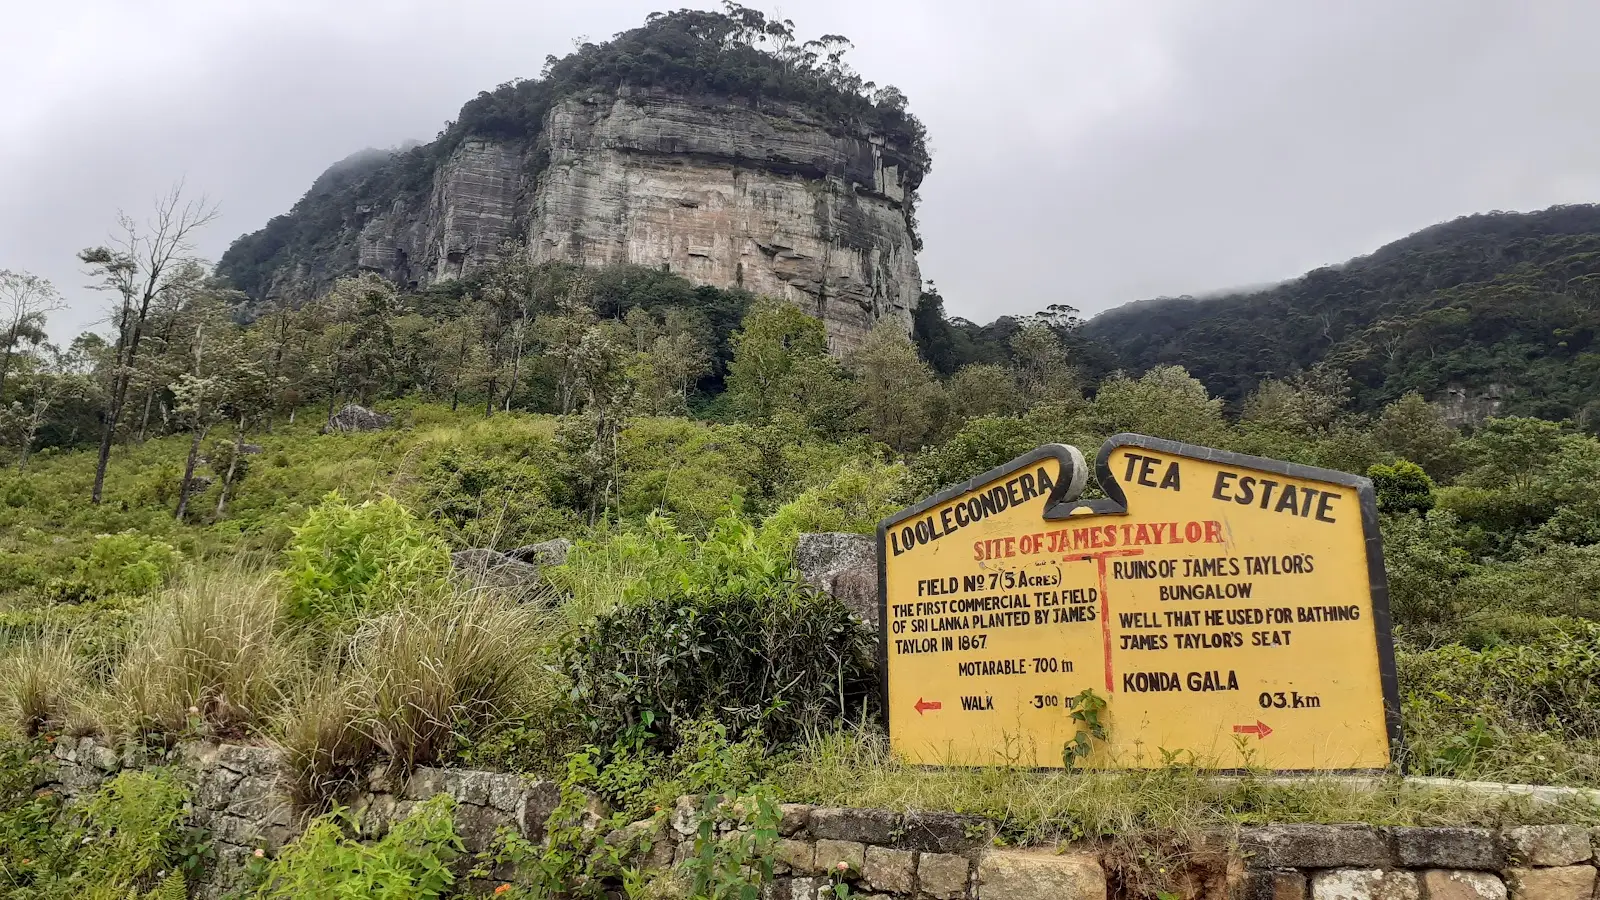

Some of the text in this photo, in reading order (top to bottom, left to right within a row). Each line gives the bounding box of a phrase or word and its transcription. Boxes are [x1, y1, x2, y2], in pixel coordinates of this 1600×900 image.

[890, 453, 1342, 557] LOOLECONDERA TEA ESTATE
[973, 520, 1225, 561] SITE OF JAMES TAYLOR
[1113, 553, 1314, 580] RUINS OF JAMES TAYLOR'S
[918, 577, 959, 597] FIELD
[1159, 583, 1252, 601] BUNGALOW
[892, 587, 1098, 618] THE FIRST COMMERCIAL TEA FIELD
[892, 620, 906, 634] OF
[911, 618, 928, 633] SRI
[931, 615, 969, 631] LANKA
[972, 610, 1030, 629] PLANTED
[1034, 608, 1050, 625] BY
[1119, 605, 1360, 629] WELL THAT HE USED FOR BATHING
[895, 637, 938, 654] TAYLOR
[941, 636, 953, 651] IN
[1120, 630, 1292, 651] JAMES TAYLOR'S SEAT
[958, 658, 1026, 677] MOTARABLE
[1123, 670, 1240, 692] KONDA GALA
[960, 695, 994, 711] WALK
